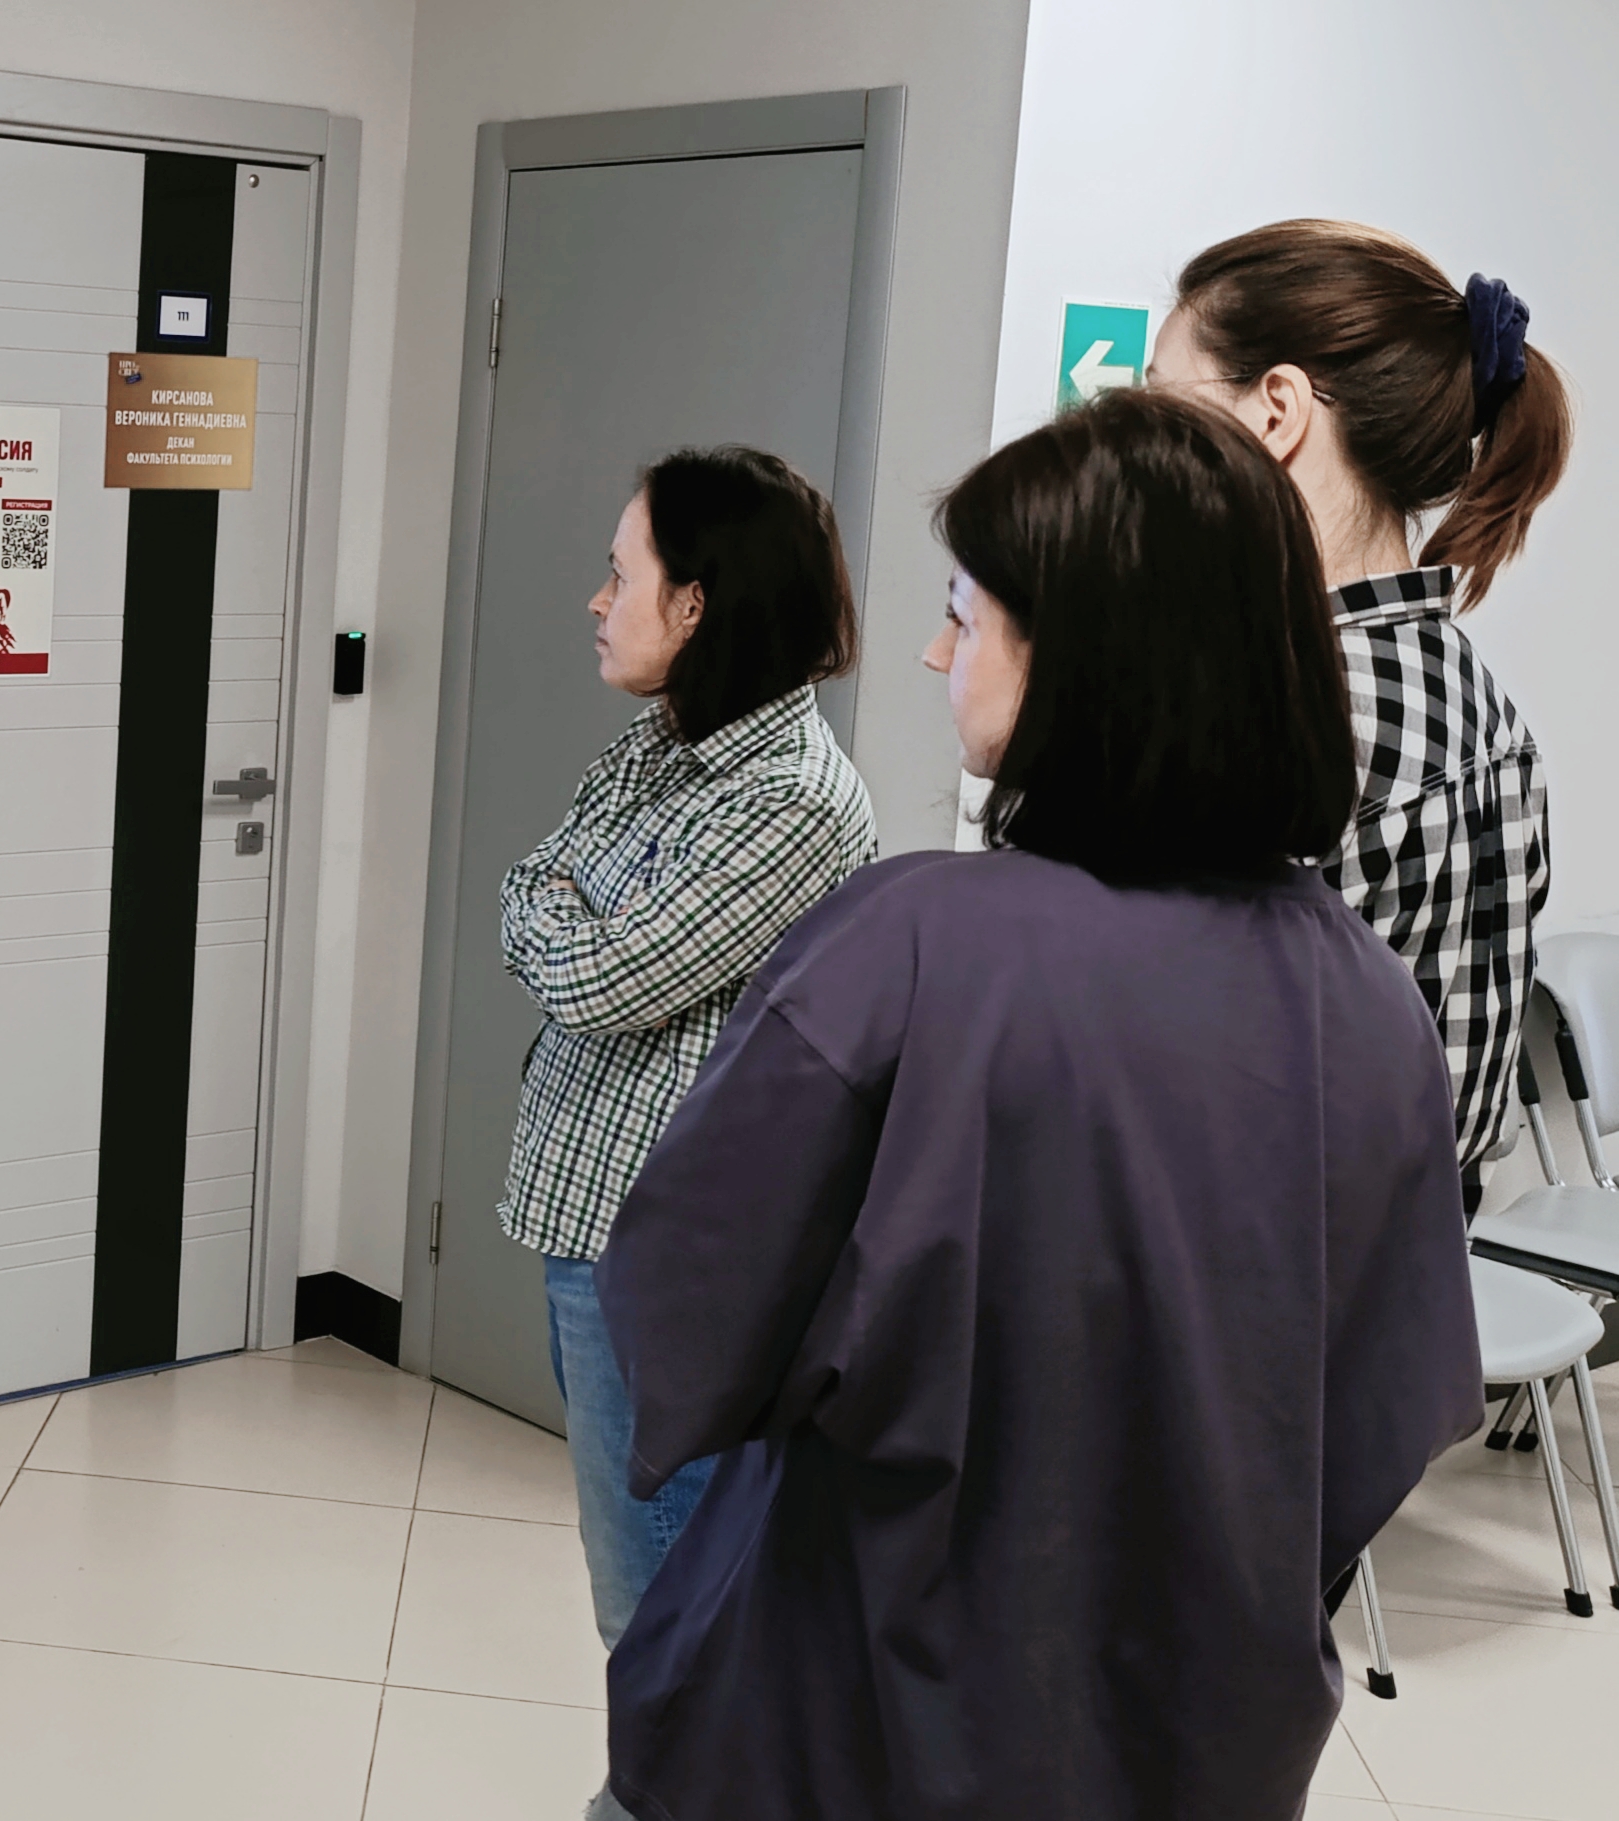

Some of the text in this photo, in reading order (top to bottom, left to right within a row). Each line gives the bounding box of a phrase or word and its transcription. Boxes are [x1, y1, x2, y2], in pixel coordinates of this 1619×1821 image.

[151, 390, 214, 407] КИРСАНОВА
[115, 410, 247, 430] ВЕРОНИКА ГЕННАДИЕВНА
[166, 437, 195, 450] ДЕКАН
[126, 452, 232, 466] ФАКУЛЬТЕТА ПСИХОЛОГИИ
